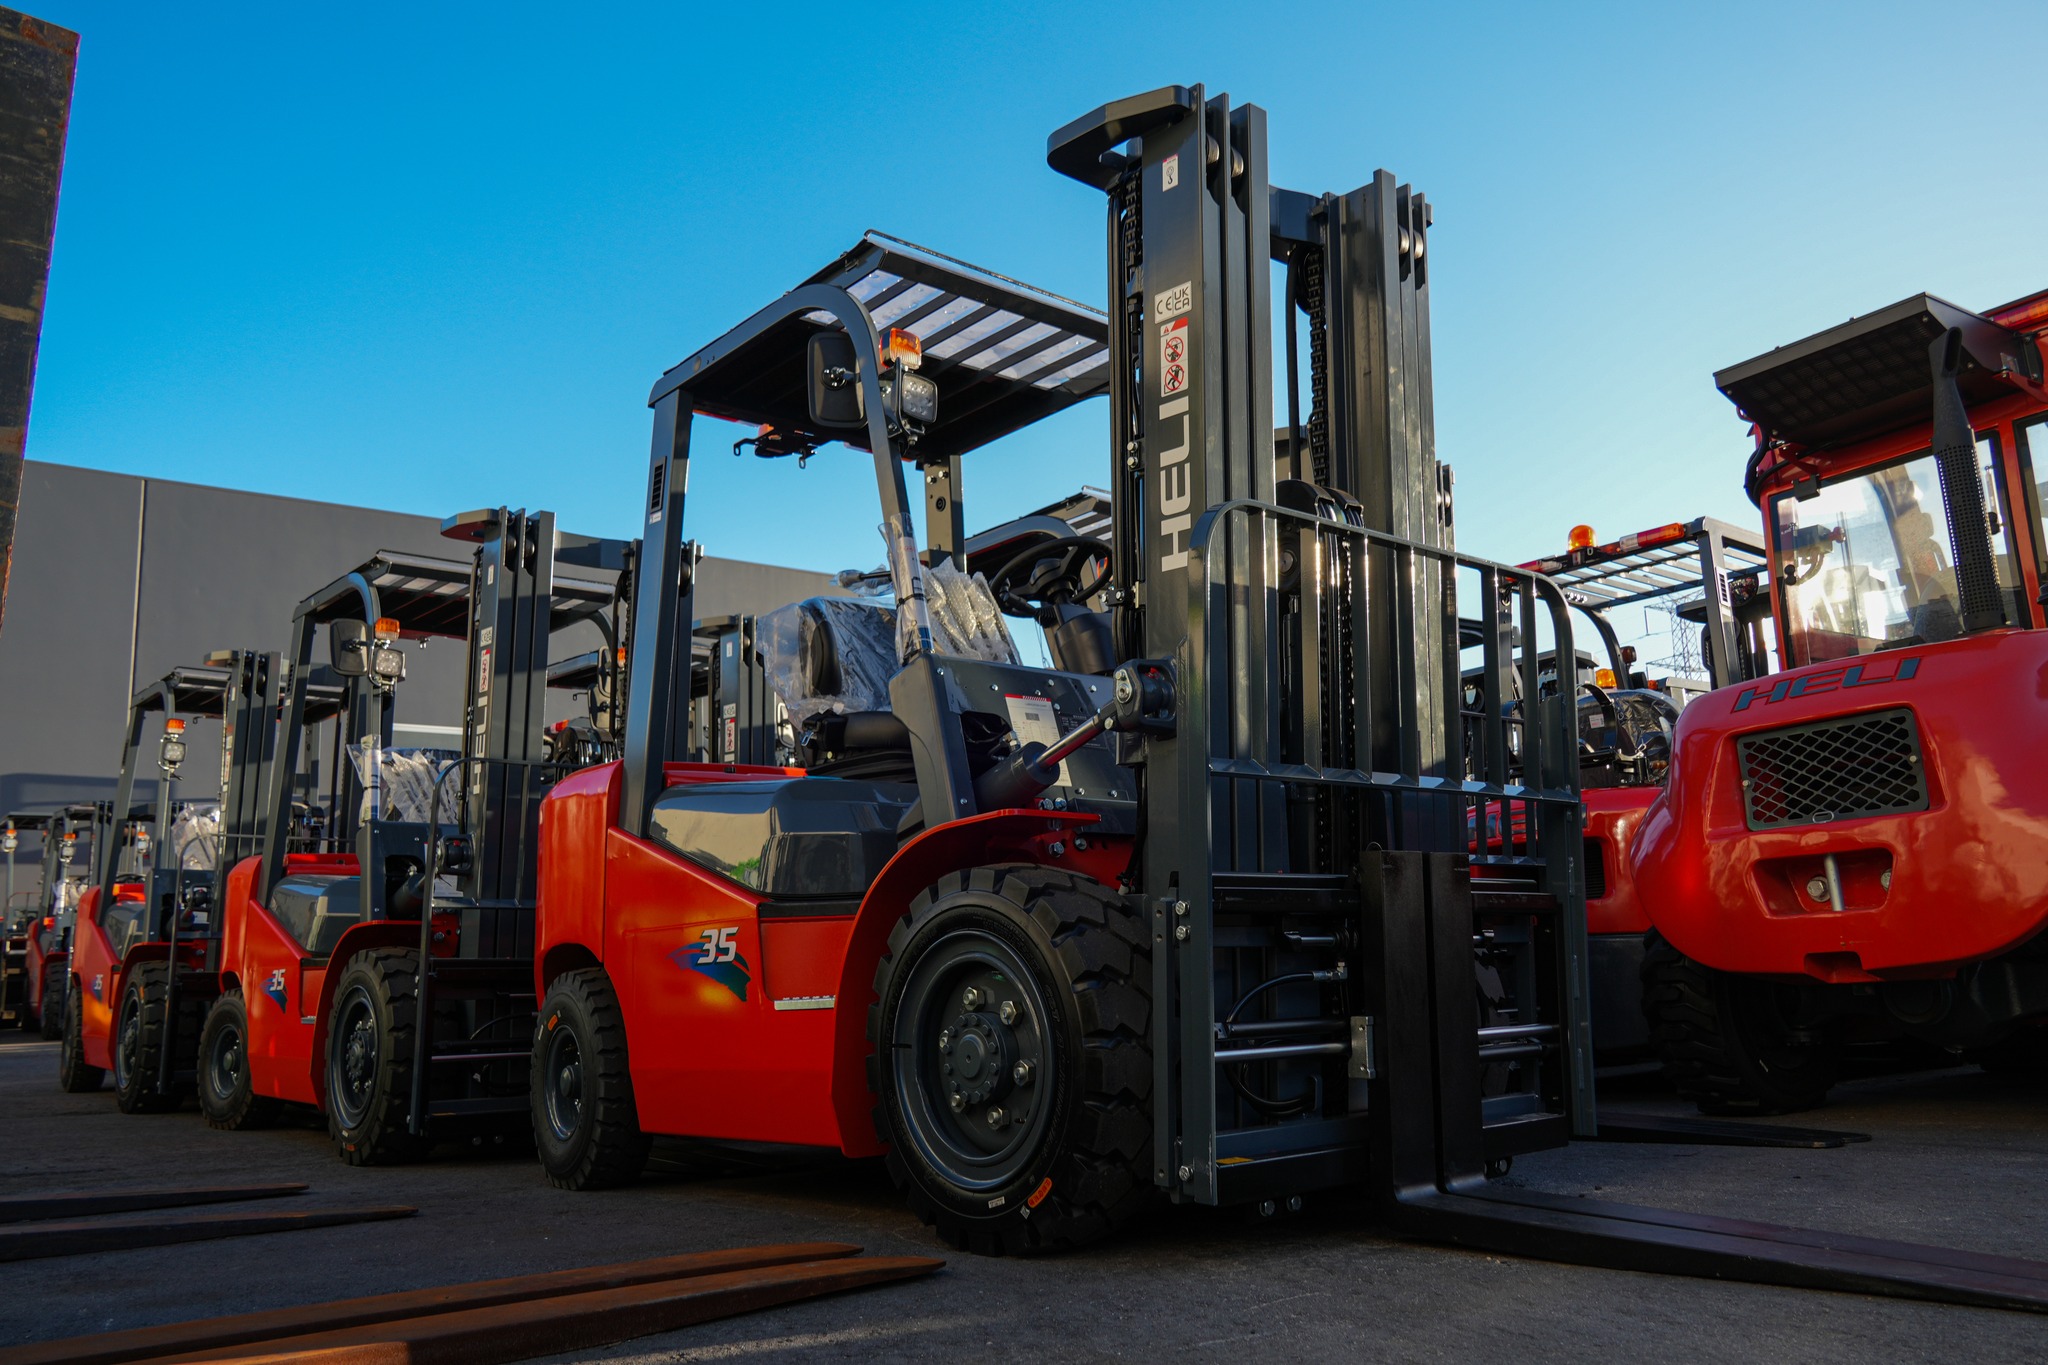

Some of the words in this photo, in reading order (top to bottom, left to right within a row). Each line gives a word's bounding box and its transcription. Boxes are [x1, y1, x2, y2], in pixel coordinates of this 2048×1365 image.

[1174, 286, 1189, 300] UK
[1174, 297, 1190, 310] CA
[1159, 396, 1191, 572] HELI
[1731, 656, 1923, 713] HELI
[473, 695, 488, 794] HELI
[697, 926, 739, 964] 35
[269, 968, 286, 991] 35
